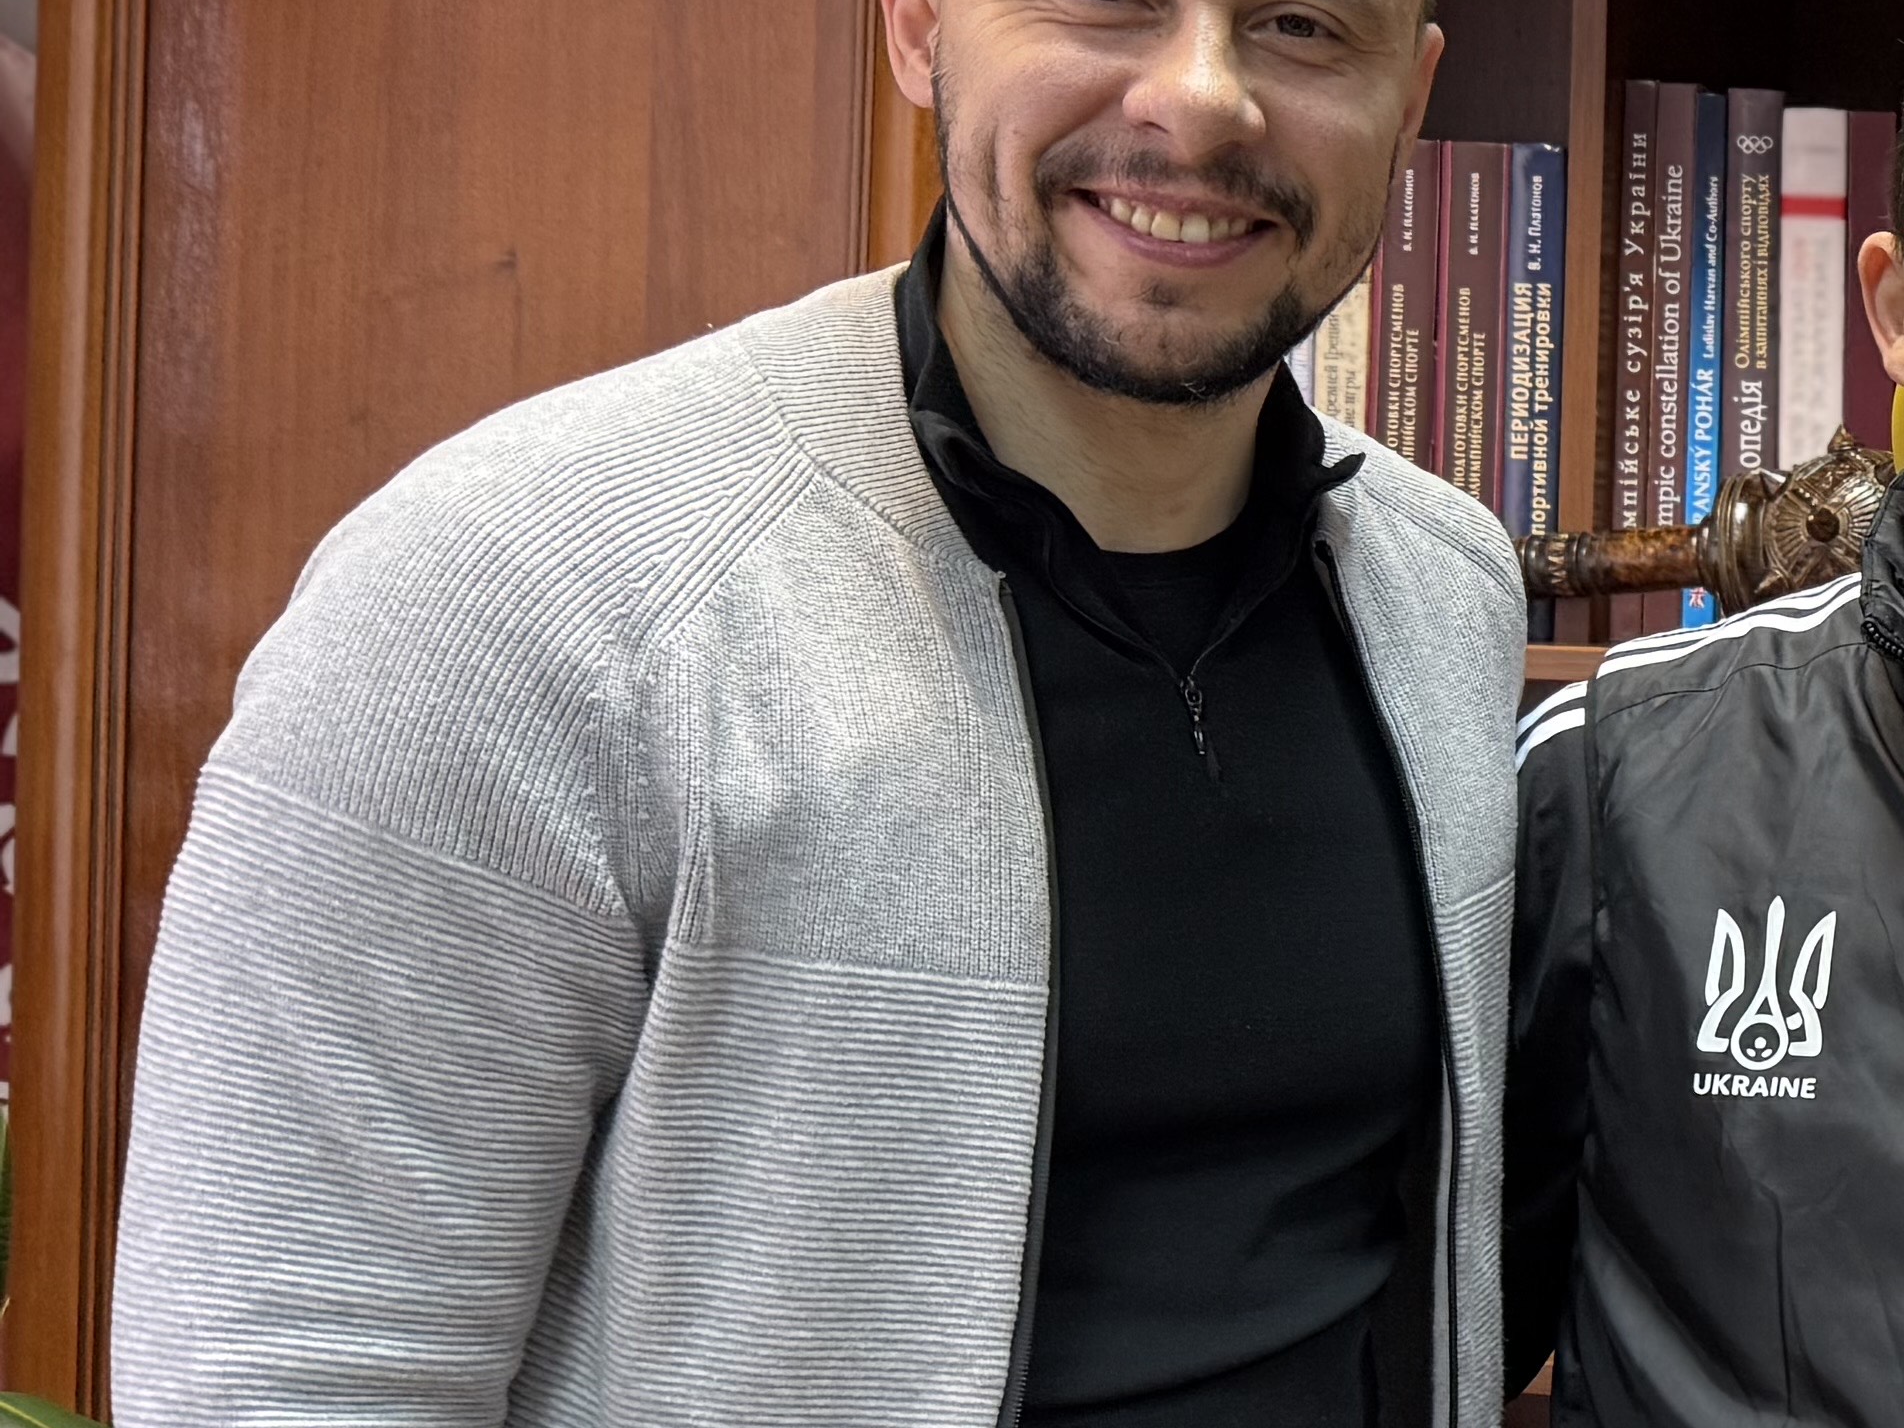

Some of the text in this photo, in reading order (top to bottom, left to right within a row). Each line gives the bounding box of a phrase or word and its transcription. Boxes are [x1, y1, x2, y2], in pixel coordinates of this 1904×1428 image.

[1527, 240, 1541, 254] Н.
[1528, 175, 1543, 237] Платонов
[1705, 176, 1719, 242] Co-Authors
[1754, 174, 1770, 256] відповідях
[1704, 268, 1717, 311] Harvan
[1705, 245, 1718, 267] and
[1734, 173, 1757, 369] Олімпійського спорту
[1456, 287, 1471, 392] СПОРТСМЕНОВ
[1618, 133, 1651, 528] мпійське сузір'я України
[1654, 164, 1683, 526] mpic constellation of Ukraine
[1756, 268, 1768, 358] запитаннях
[1387, 284, 1405, 448] ОТОВКИ СПОРТСМЕНОВ
[1402, 329, 1420, 462] ПИЙСКОМ СПОРТЕ
[1471, 332, 1486, 386] СПОРТЕ
[1510, 282, 1535, 460] ПЕРИОДИЗАЦИЯ
[1530, 282, 1553, 535] портивной тренировки
[1690, 368, 1714, 441] POHÁR
[1733, 380, 1767, 469] опедія
[1693, 1072, 1817, 1099] UKRAINE
